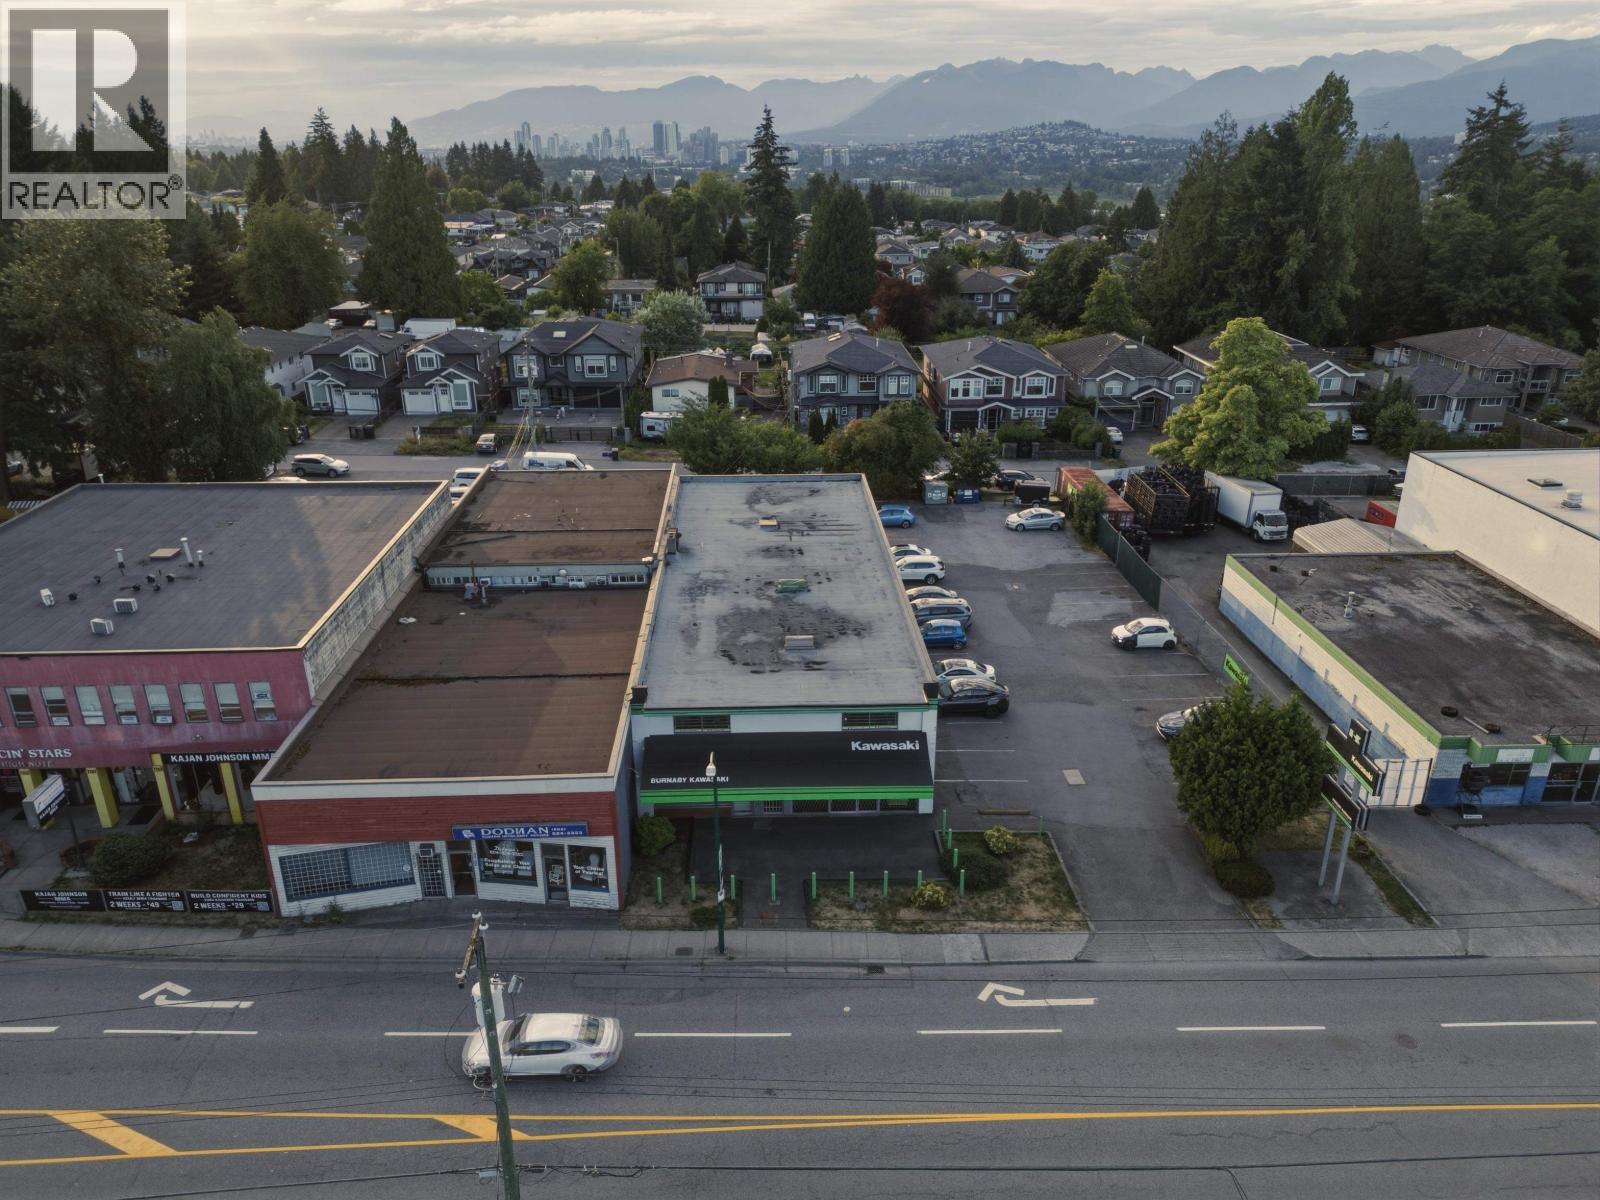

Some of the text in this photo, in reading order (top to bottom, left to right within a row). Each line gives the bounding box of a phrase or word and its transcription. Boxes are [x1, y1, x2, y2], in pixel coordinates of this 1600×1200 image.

[851, 739, 920, 751] Kawasaki
[28, 748, 72, 758] STARS
[170, 754, 203, 763] KAJAN
[205, 753, 250, 762] JOHNSON
